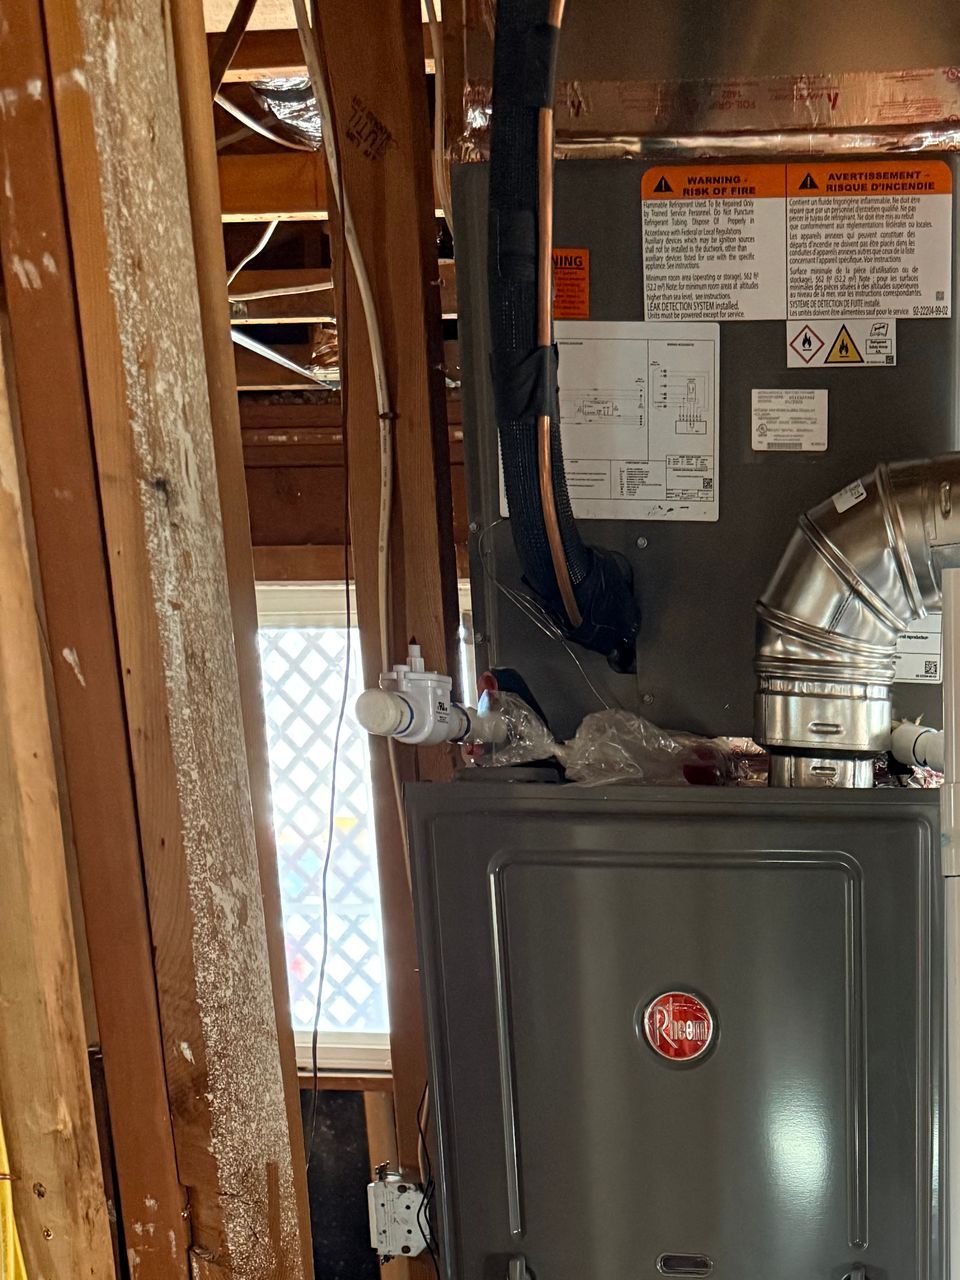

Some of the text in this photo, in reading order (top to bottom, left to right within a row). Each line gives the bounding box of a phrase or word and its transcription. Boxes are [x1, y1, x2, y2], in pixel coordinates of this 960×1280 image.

[687, 176, 740, 185] WARNING
[828, 171, 922, 181] AVERTISSEMENT
[683, 186, 756, 197] RISK OF FIRE
[826, 182, 935, 192] RISQUE D'INCENDIE
[653, 997, 708, 1048] Rheem
